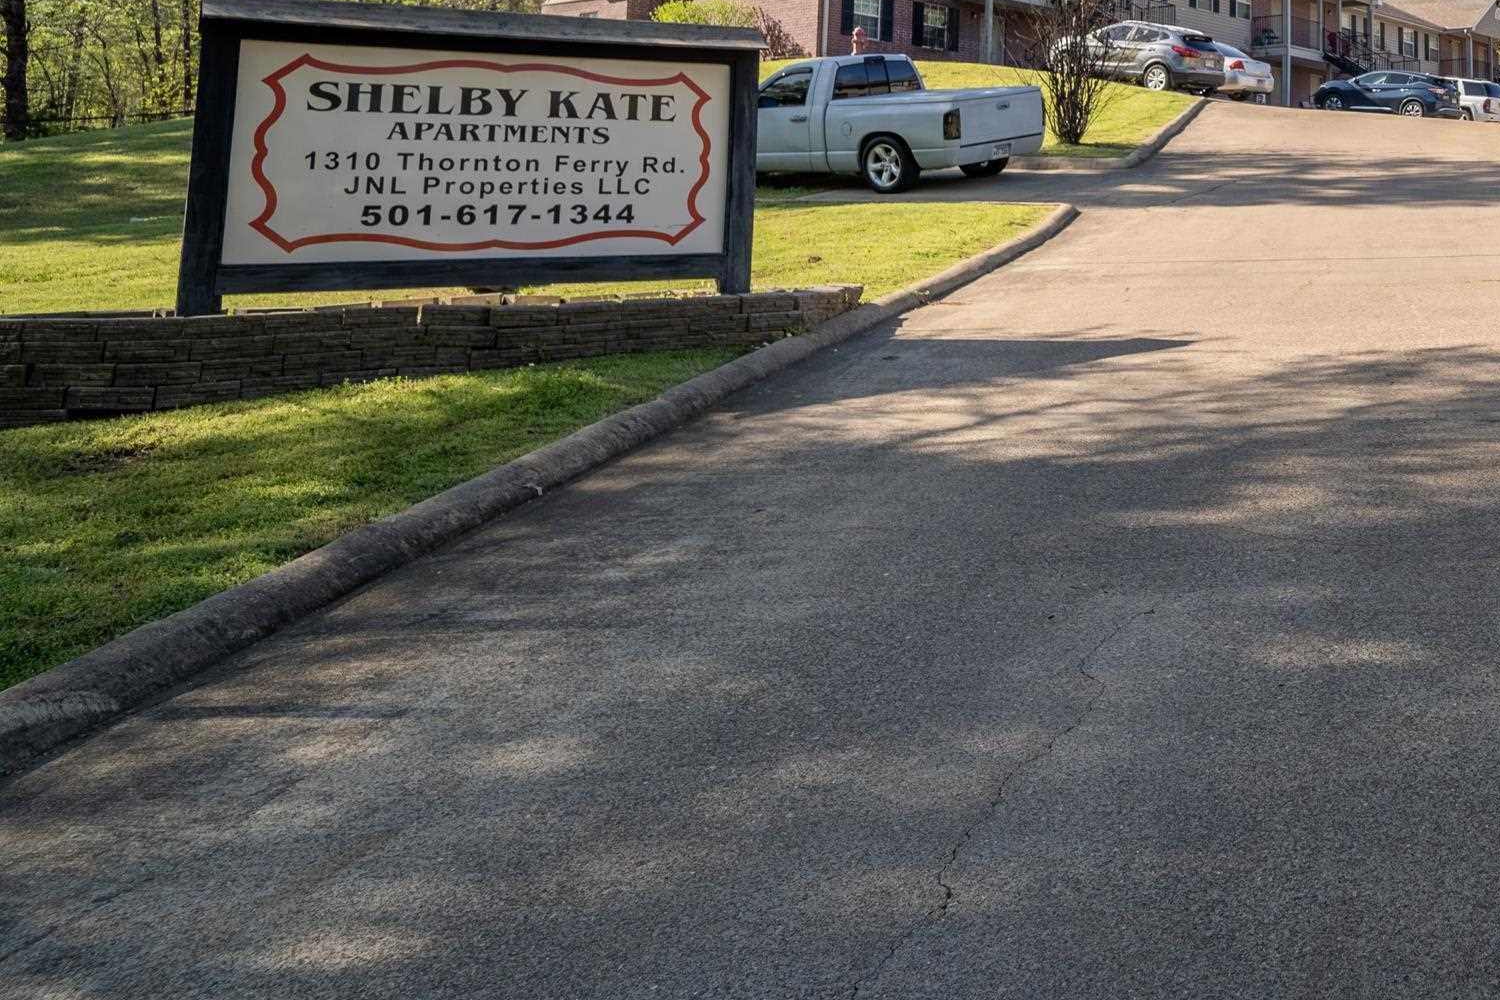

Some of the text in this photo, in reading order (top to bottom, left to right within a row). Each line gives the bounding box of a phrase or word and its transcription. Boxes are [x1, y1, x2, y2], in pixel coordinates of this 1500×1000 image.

[306, 80, 677, 123] SHELBY KATE
[386, 121, 611, 145] APARTMENTS
[304, 150, 685, 178] 1310 Thornton Ferry Rd.
[343, 175, 651, 200] JNL Properties LLC
[359, 203, 635, 227] 501-617-1344
